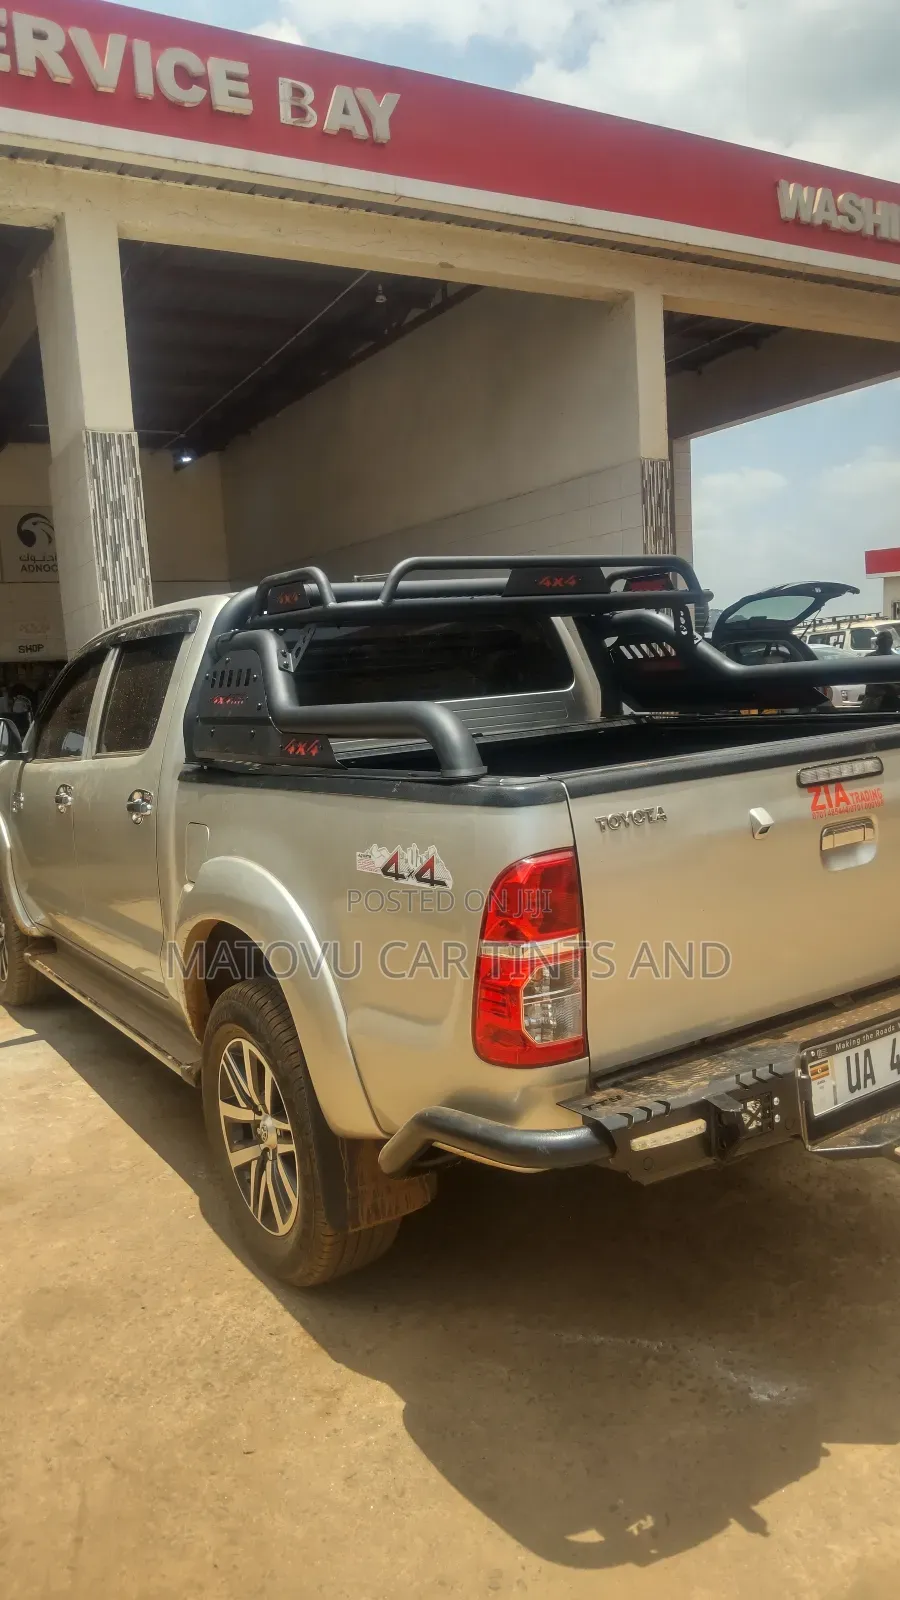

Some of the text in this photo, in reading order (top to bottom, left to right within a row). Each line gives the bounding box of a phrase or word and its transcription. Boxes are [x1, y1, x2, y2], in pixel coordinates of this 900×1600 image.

[0, 8, 401, 144] RVICE BAY
[20, 563, 58, 573] ADNOC
[18, 644, 44, 653] SHOP
[807, 782, 883, 811] ZIA TRADING
[595, 806, 667, 832] TOYOTA
[835, 1038, 861, 1051] Making
[862, 1033, 874, 1041] the
[875, 1025, 895, 1037] Roads
[845, 1048, 877, 1094] UA
